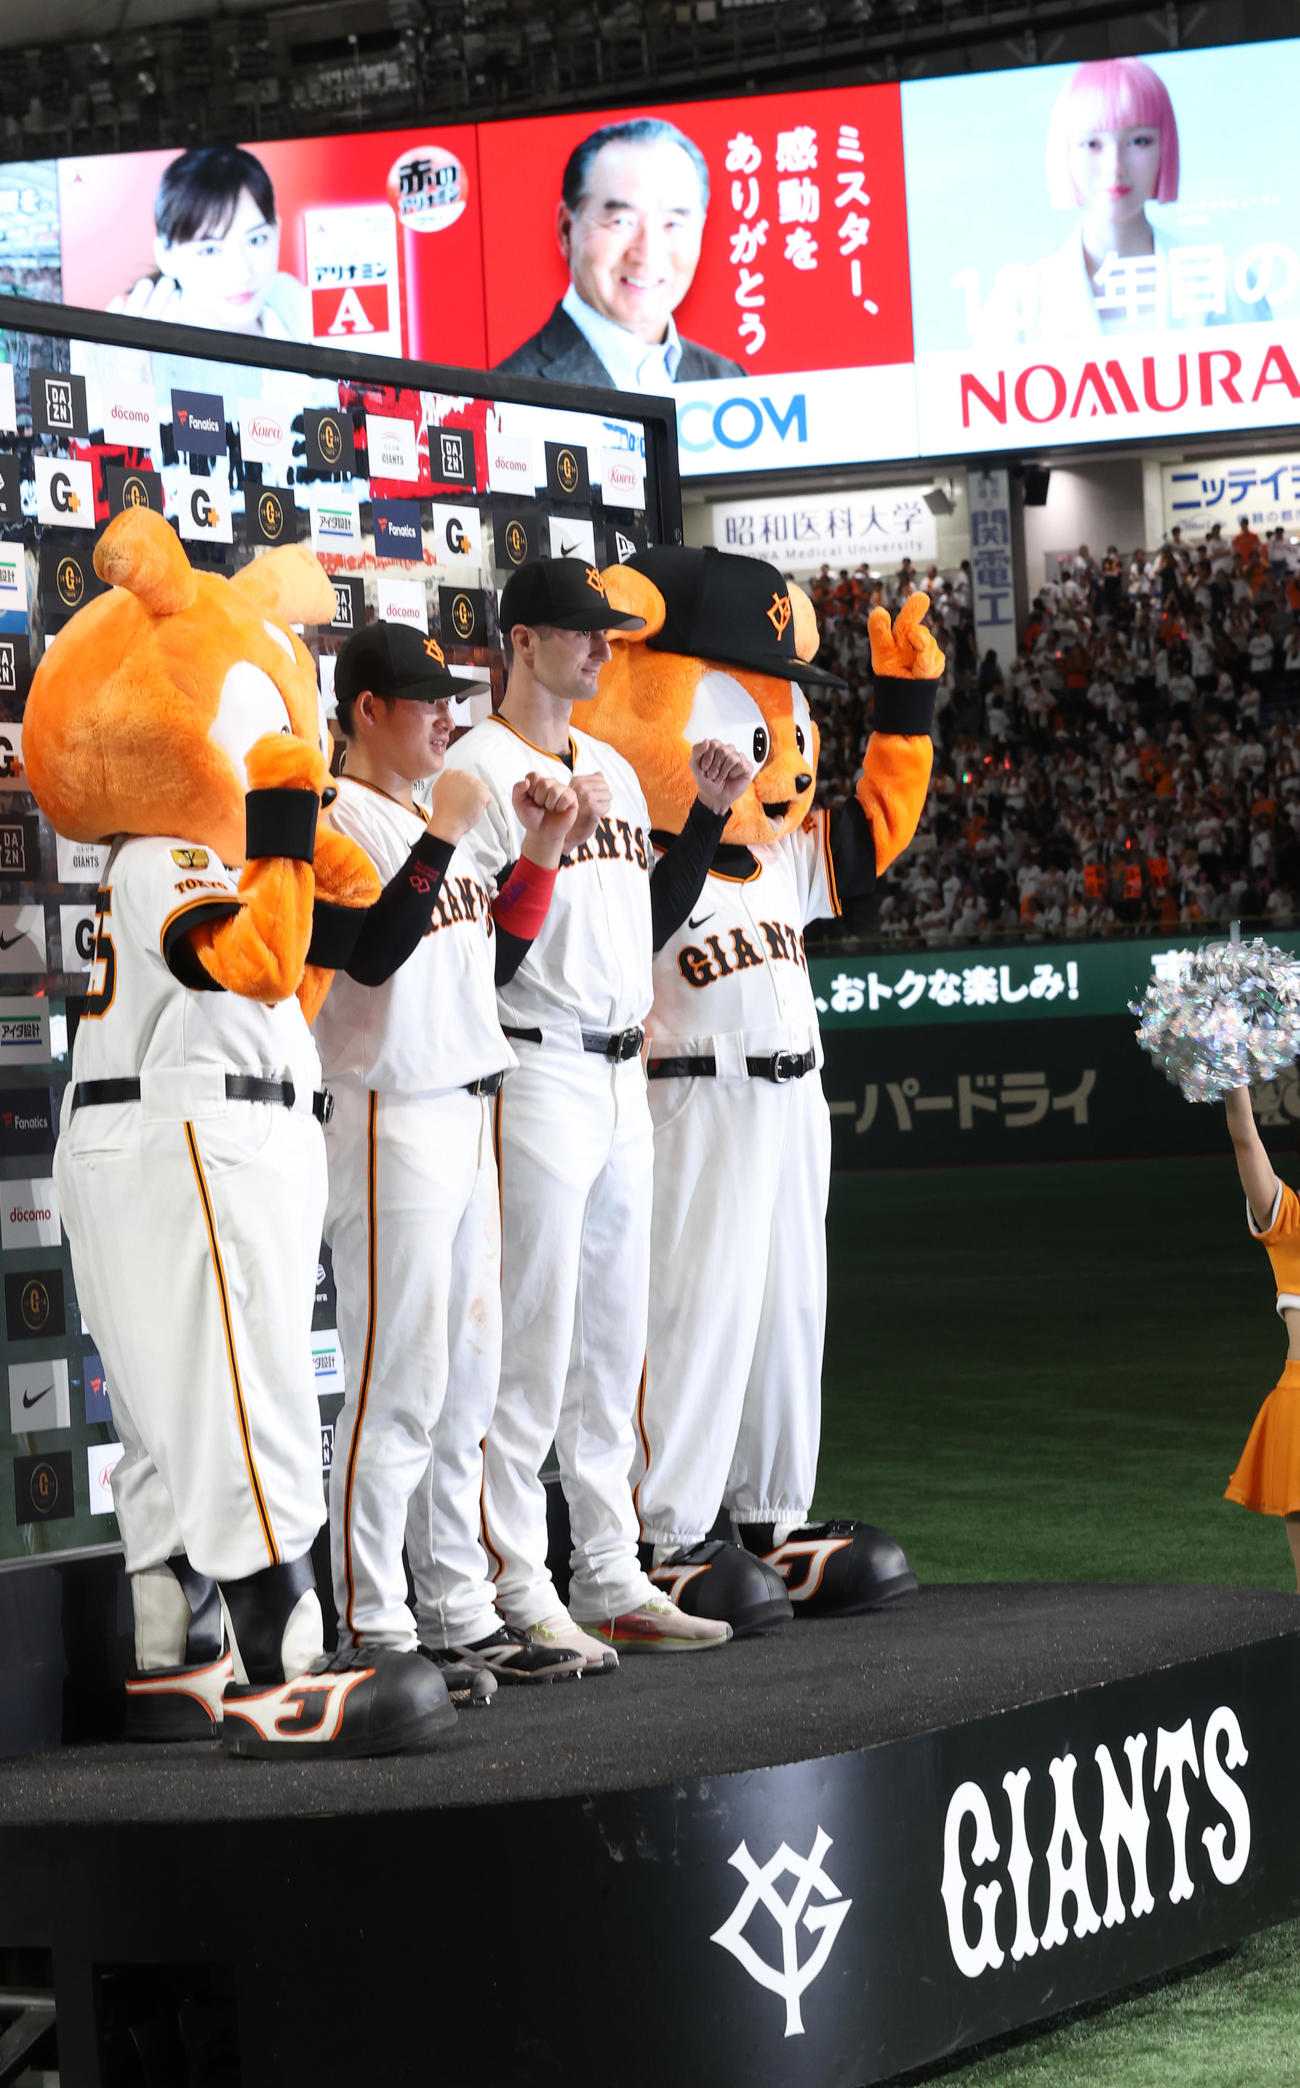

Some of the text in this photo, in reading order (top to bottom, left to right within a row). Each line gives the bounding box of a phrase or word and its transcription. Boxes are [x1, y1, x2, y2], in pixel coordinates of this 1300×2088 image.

[775, 126, 820, 270] 感動を
[834, 125, 879, 314] ミスター、
[725, 132, 769, 355] ありがとう
[315, 262, 388, 283] アリナミン
[327, 286, 375, 335] A
[960, 344, 1300, 428] NOMURA
[111, 405, 149, 423] docomo
[188, 414, 220, 433] Fanatics
[495, 456, 527, 472] docomo
[388, 521, 416, 538] Fanatics
[725, 502, 923, 546] 昭和医科大学
[786, 546, 843, 558] Medical
[848, 540, 923, 554] University
[971, 509, 1013, 626] 関電工
[386, 603, 421, 619] docomo
[73, 855, 99, 868] GIANTS
[174, 878, 229, 894] TOKYO
[421, 876, 494, 940] IANTS
[1, 1024, 40, 1039] アイダ設計
[14, 1114, 48, 1130] Fanatics
[10, 1206, 52, 1224] docomo
[940, 1705, 1251, 1979] GIANTS
